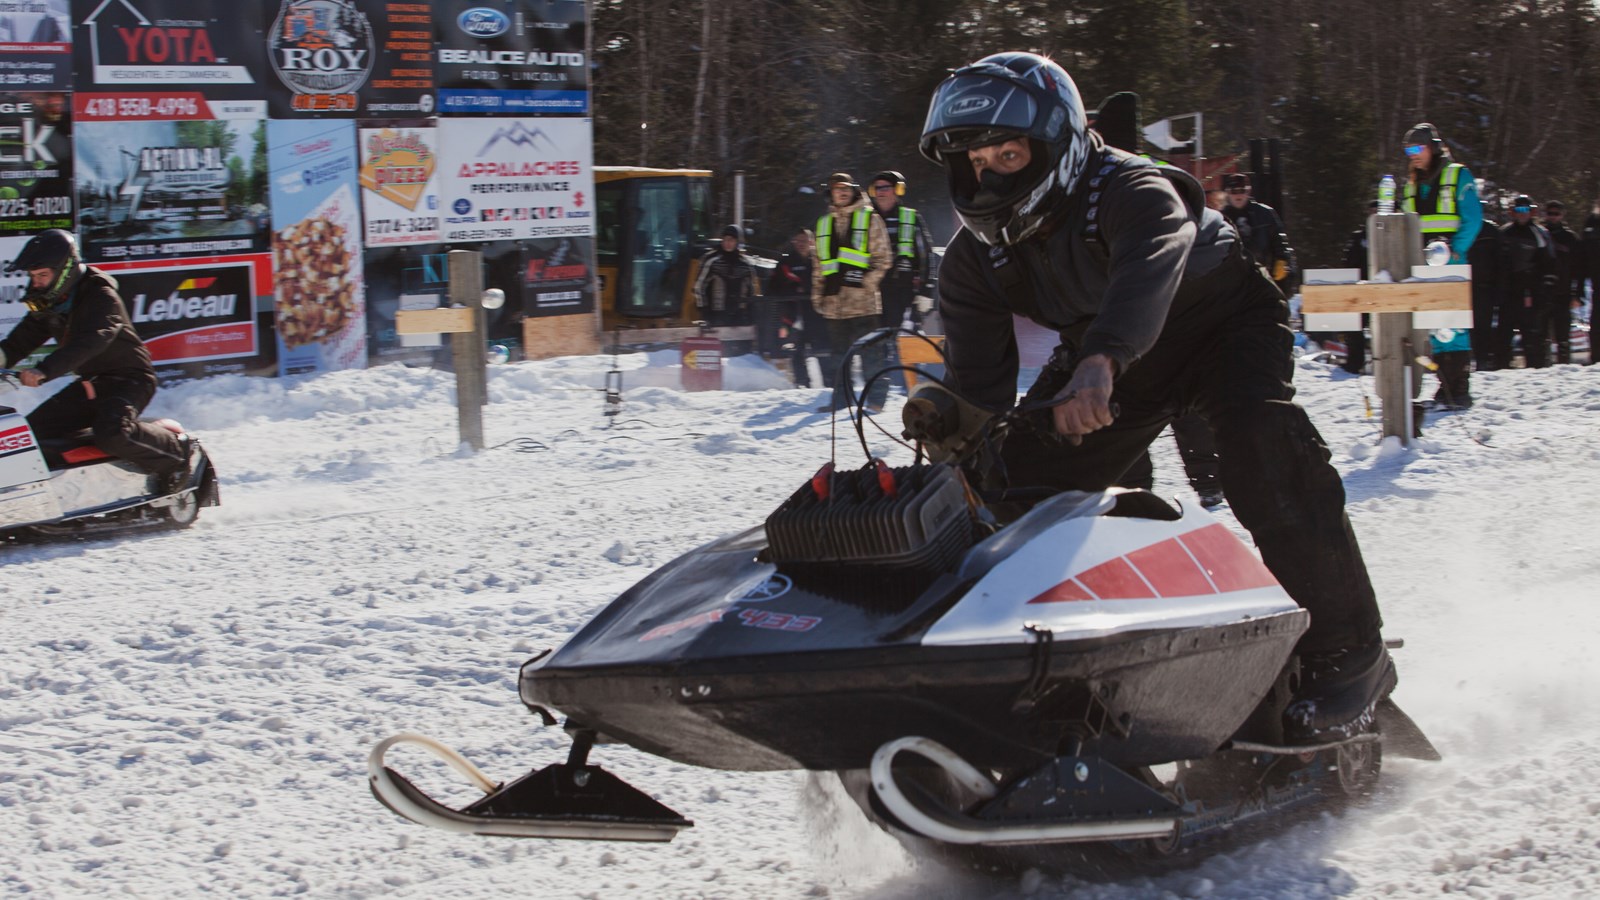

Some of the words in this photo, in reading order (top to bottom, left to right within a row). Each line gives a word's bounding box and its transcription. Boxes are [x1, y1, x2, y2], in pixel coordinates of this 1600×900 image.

[464, 11, 502, 32] Ford
[117, 27, 216, 63] YOTA
[279, 48, 367, 70] ROY
[438, 49, 525, 65] BEAUCE
[526, 52, 585, 66] AUTO
[461, 70, 500, 81] FORD
[512, 72, 568, 82] LINCOLN
[85, 97, 117, 116] 418
[950, 97, 983, 113] HJC
[374, 163, 428, 192] pizza
[457, 161, 580, 178] APPALACHES
[470, 182, 571, 193] PERFORMANCE
[132, 291, 237, 323] Lebeau
[738, 609, 822, 632] 433
